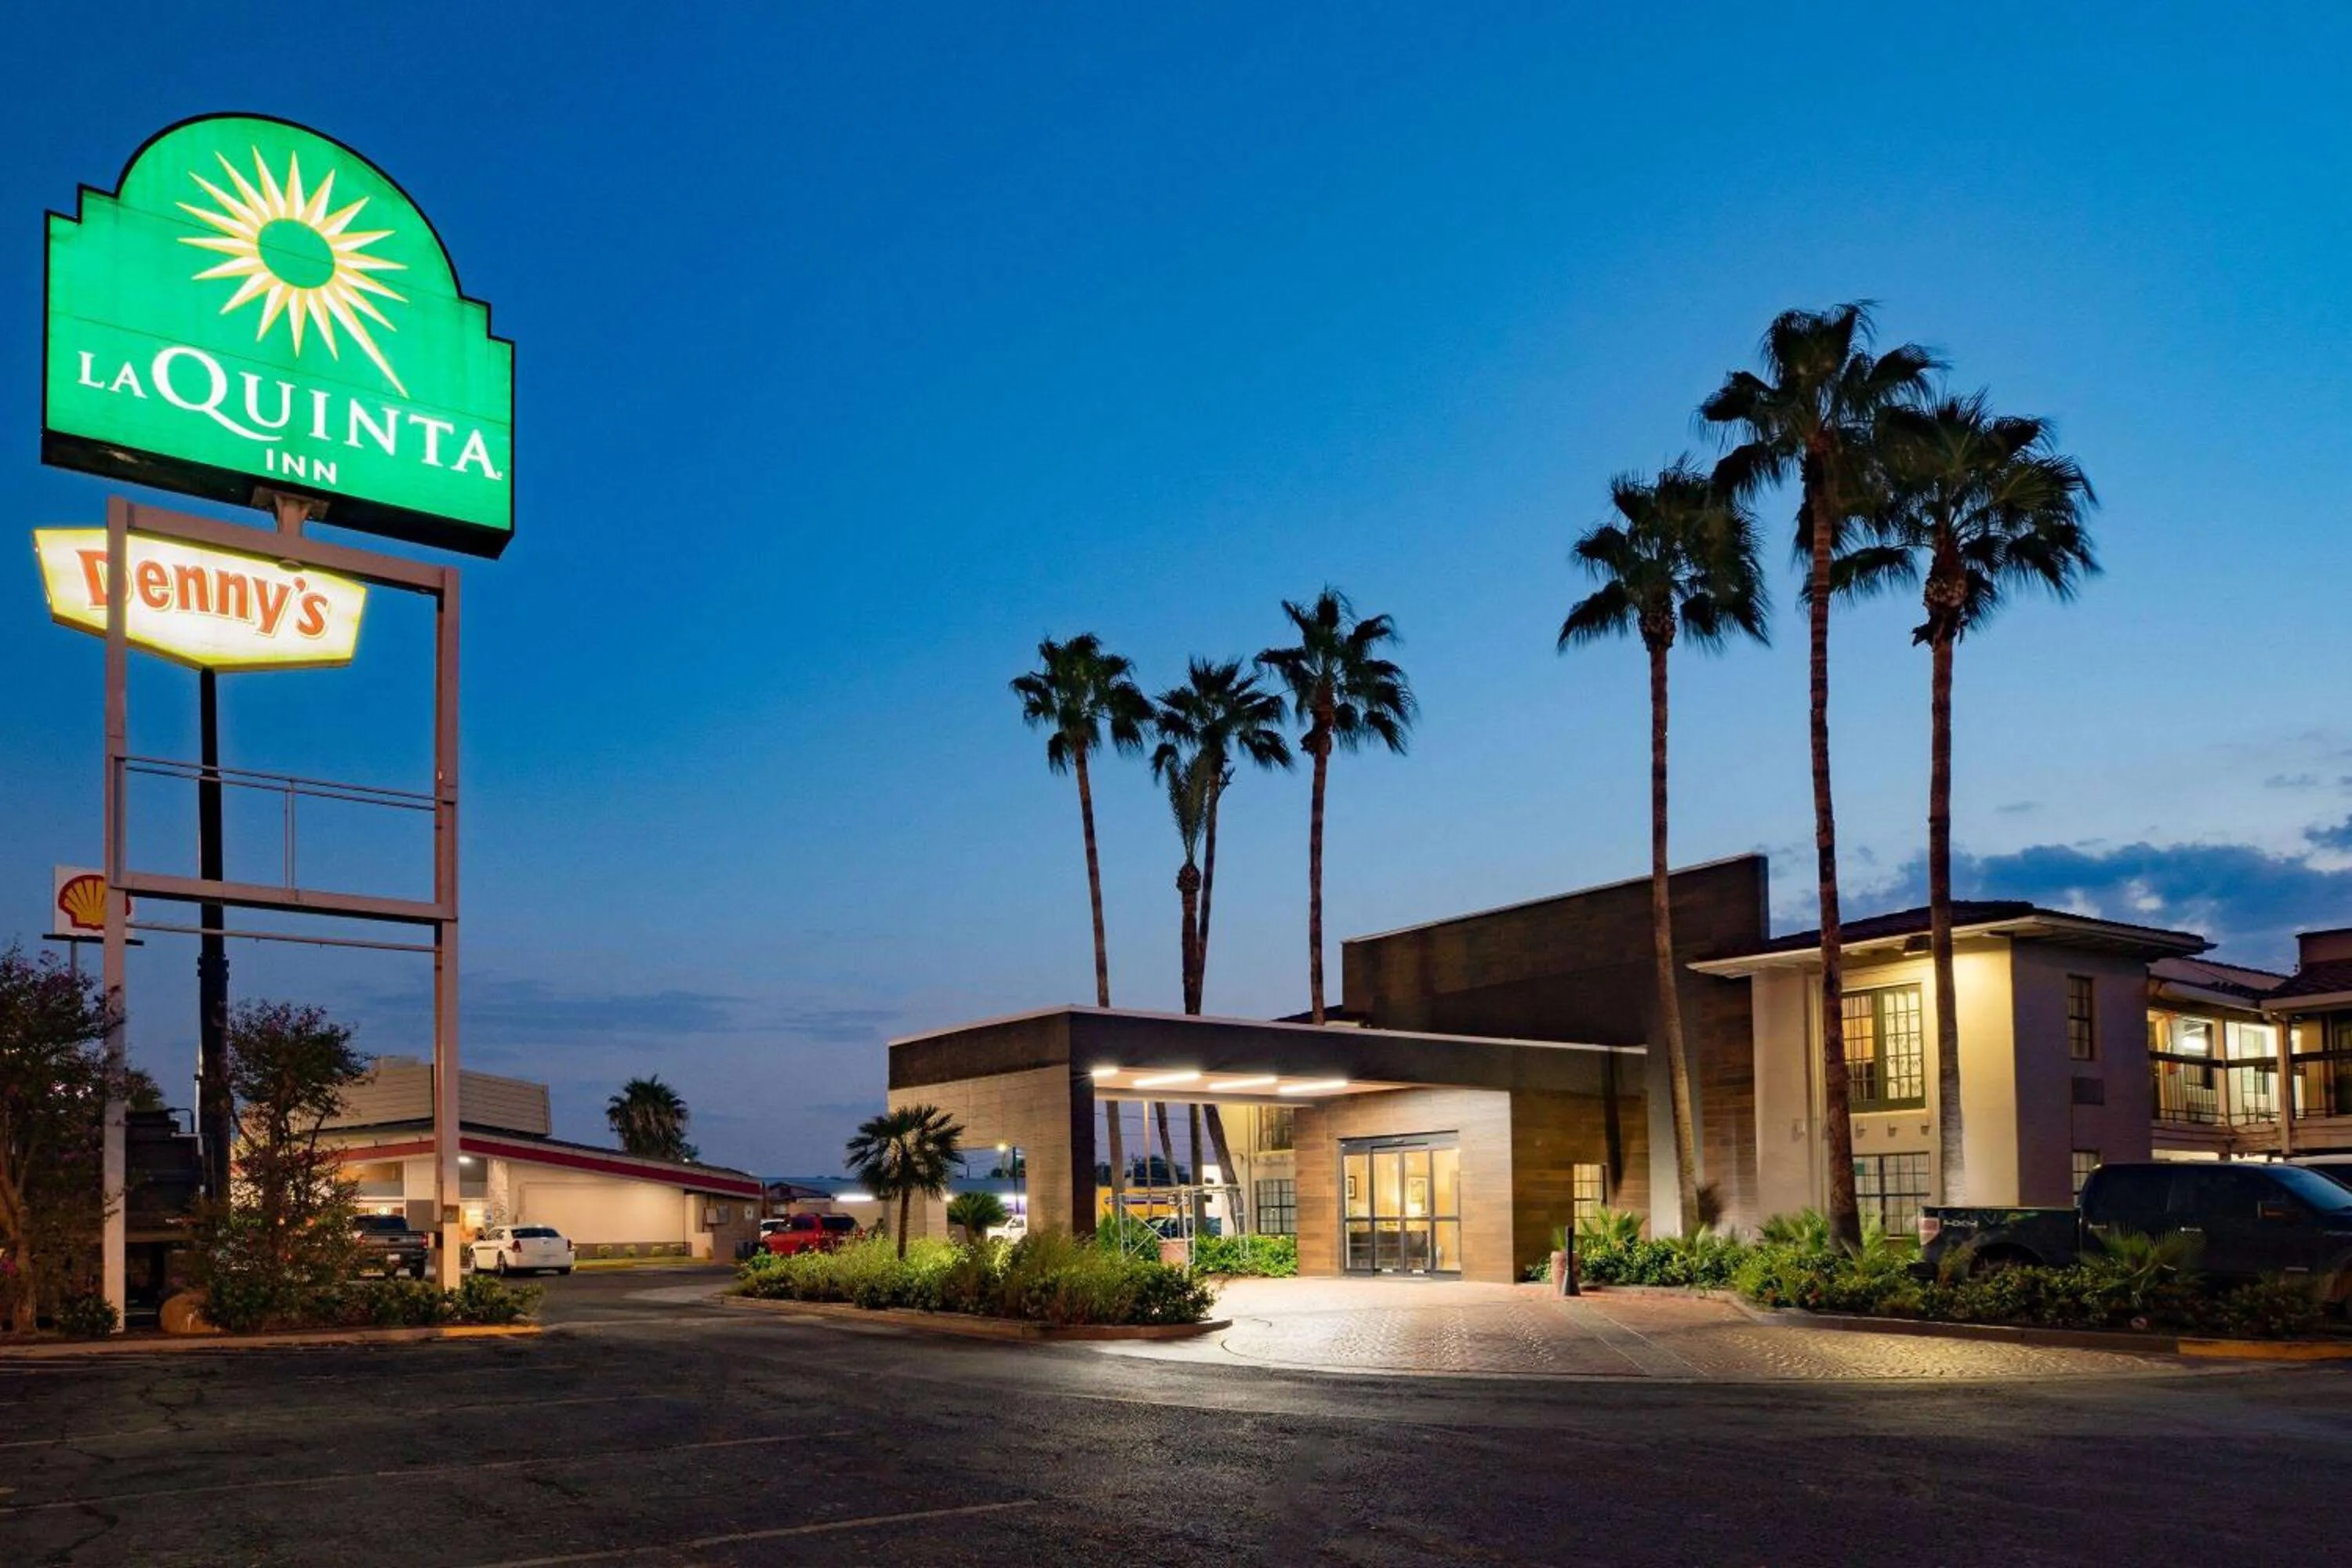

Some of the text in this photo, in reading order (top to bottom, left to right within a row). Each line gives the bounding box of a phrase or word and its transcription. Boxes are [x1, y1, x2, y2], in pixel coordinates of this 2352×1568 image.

[77, 346, 503, 481] LA QUINTA
[266, 448, 337, 485] INN
